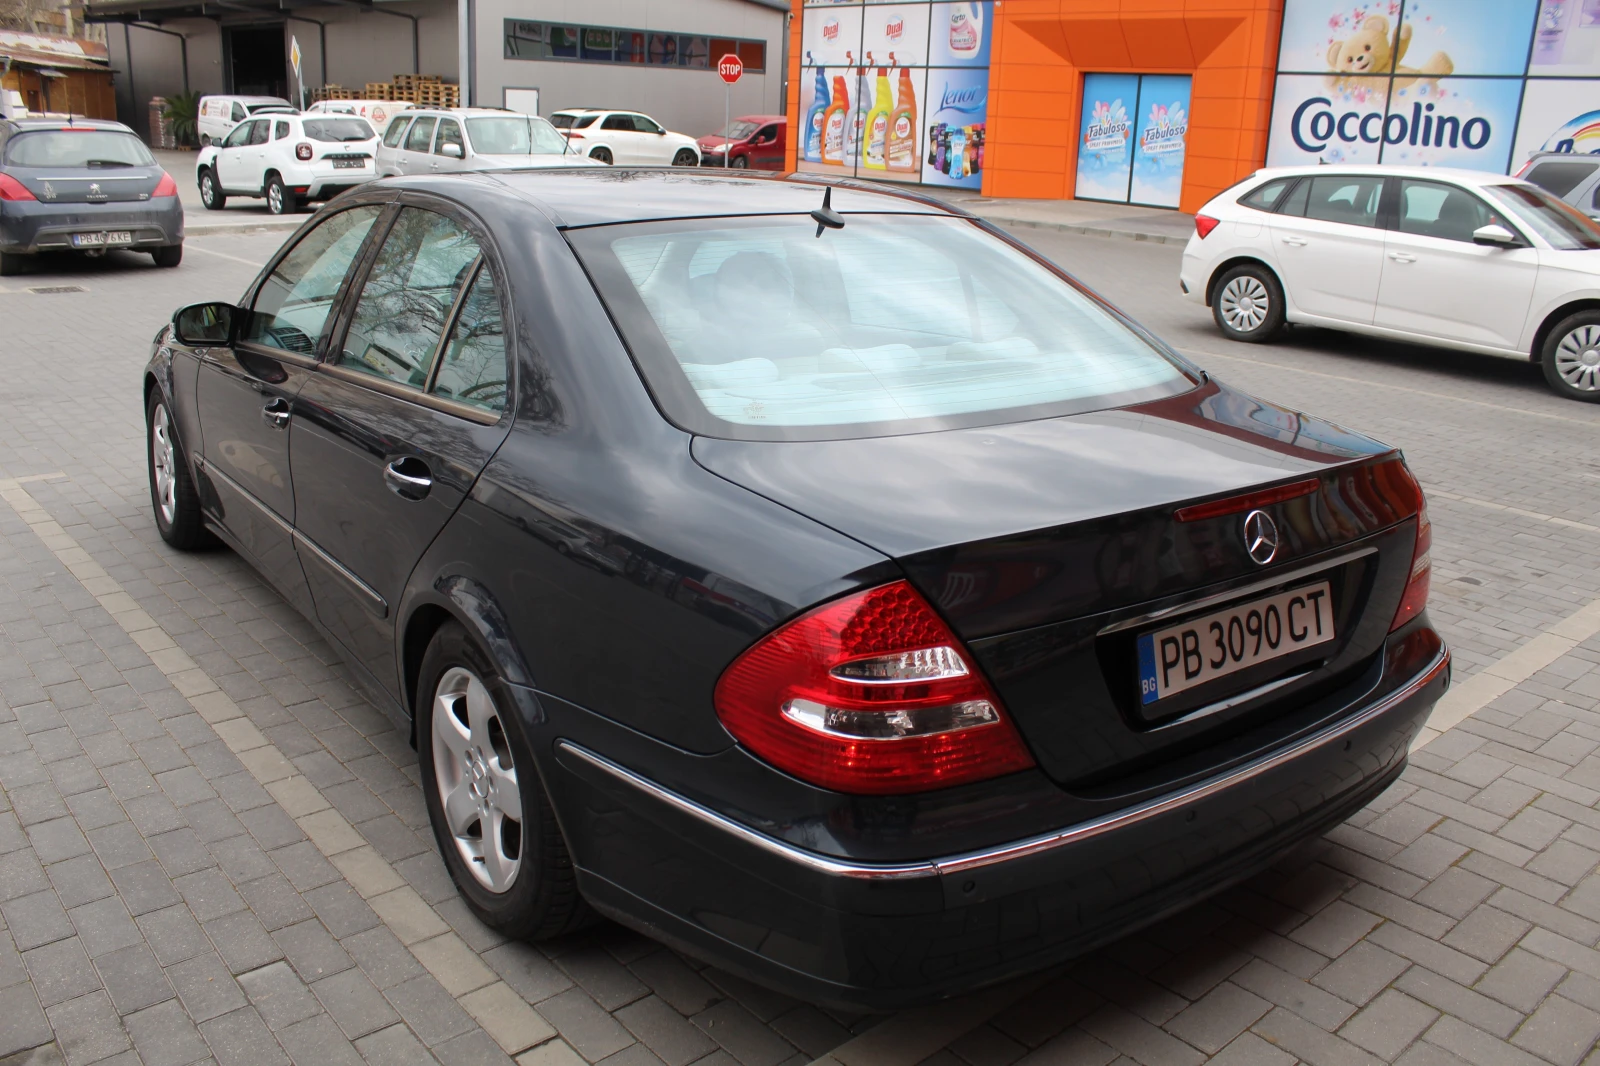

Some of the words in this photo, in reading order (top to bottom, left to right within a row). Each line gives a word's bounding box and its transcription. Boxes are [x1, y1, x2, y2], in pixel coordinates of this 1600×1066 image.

[823, 22, 839, 37] Dual
[886, 20, 903, 36] Dual
[720, 63, 741, 76] STOP
[940, 82, 981, 111] Lenor
[1088, 122, 1126, 138] Fabuloso
[1291, 97, 1491, 152] Coccolino
[1145, 125, 1185, 142] Fabuloso
[80, 234, 92, 244] PB
[94, 233, 116, 243] 406
[117, 232, 129, 242] KE
[1160, 629, 1203, 689] PB
[1209, 603, 1282, 670] 3090
[1288, 589, 1325, 643] CT
[1142, 676, 1156, 695] BG
